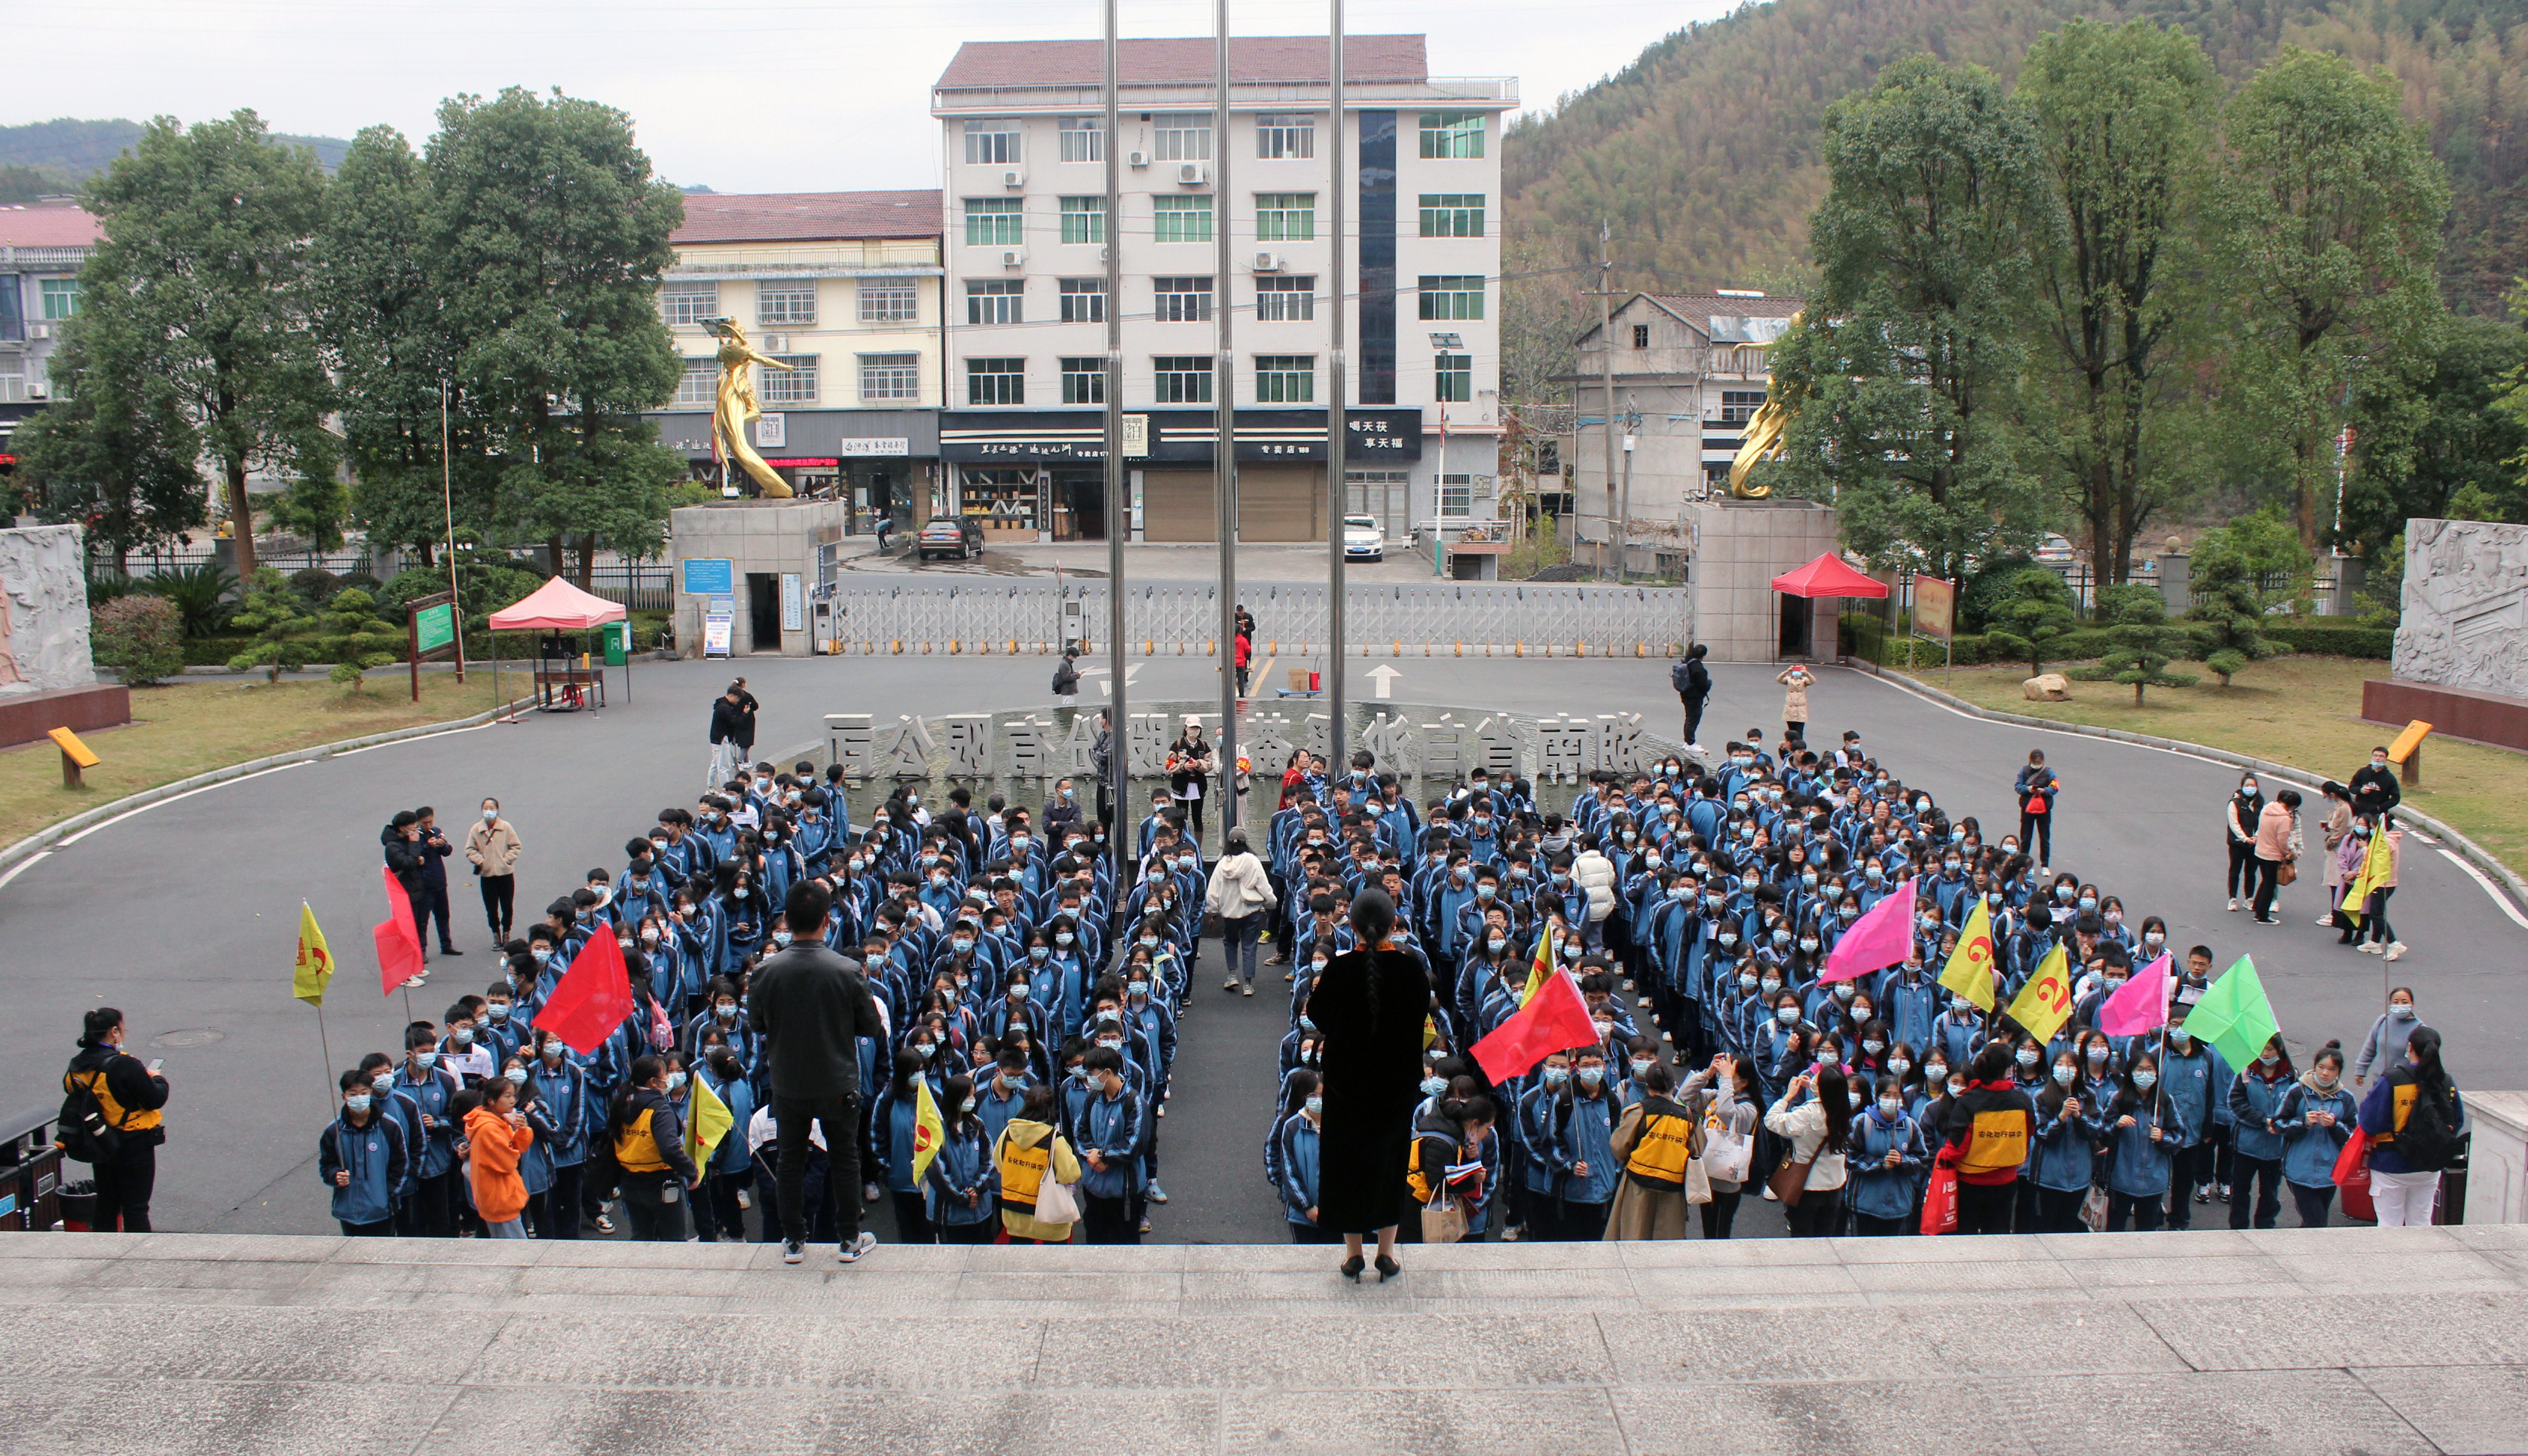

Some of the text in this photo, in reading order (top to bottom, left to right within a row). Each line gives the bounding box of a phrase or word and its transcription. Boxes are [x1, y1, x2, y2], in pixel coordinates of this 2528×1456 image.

[1349, 421, 1388, 433] 喝天茯
[1364, 437, 1403, 448] 享天福
